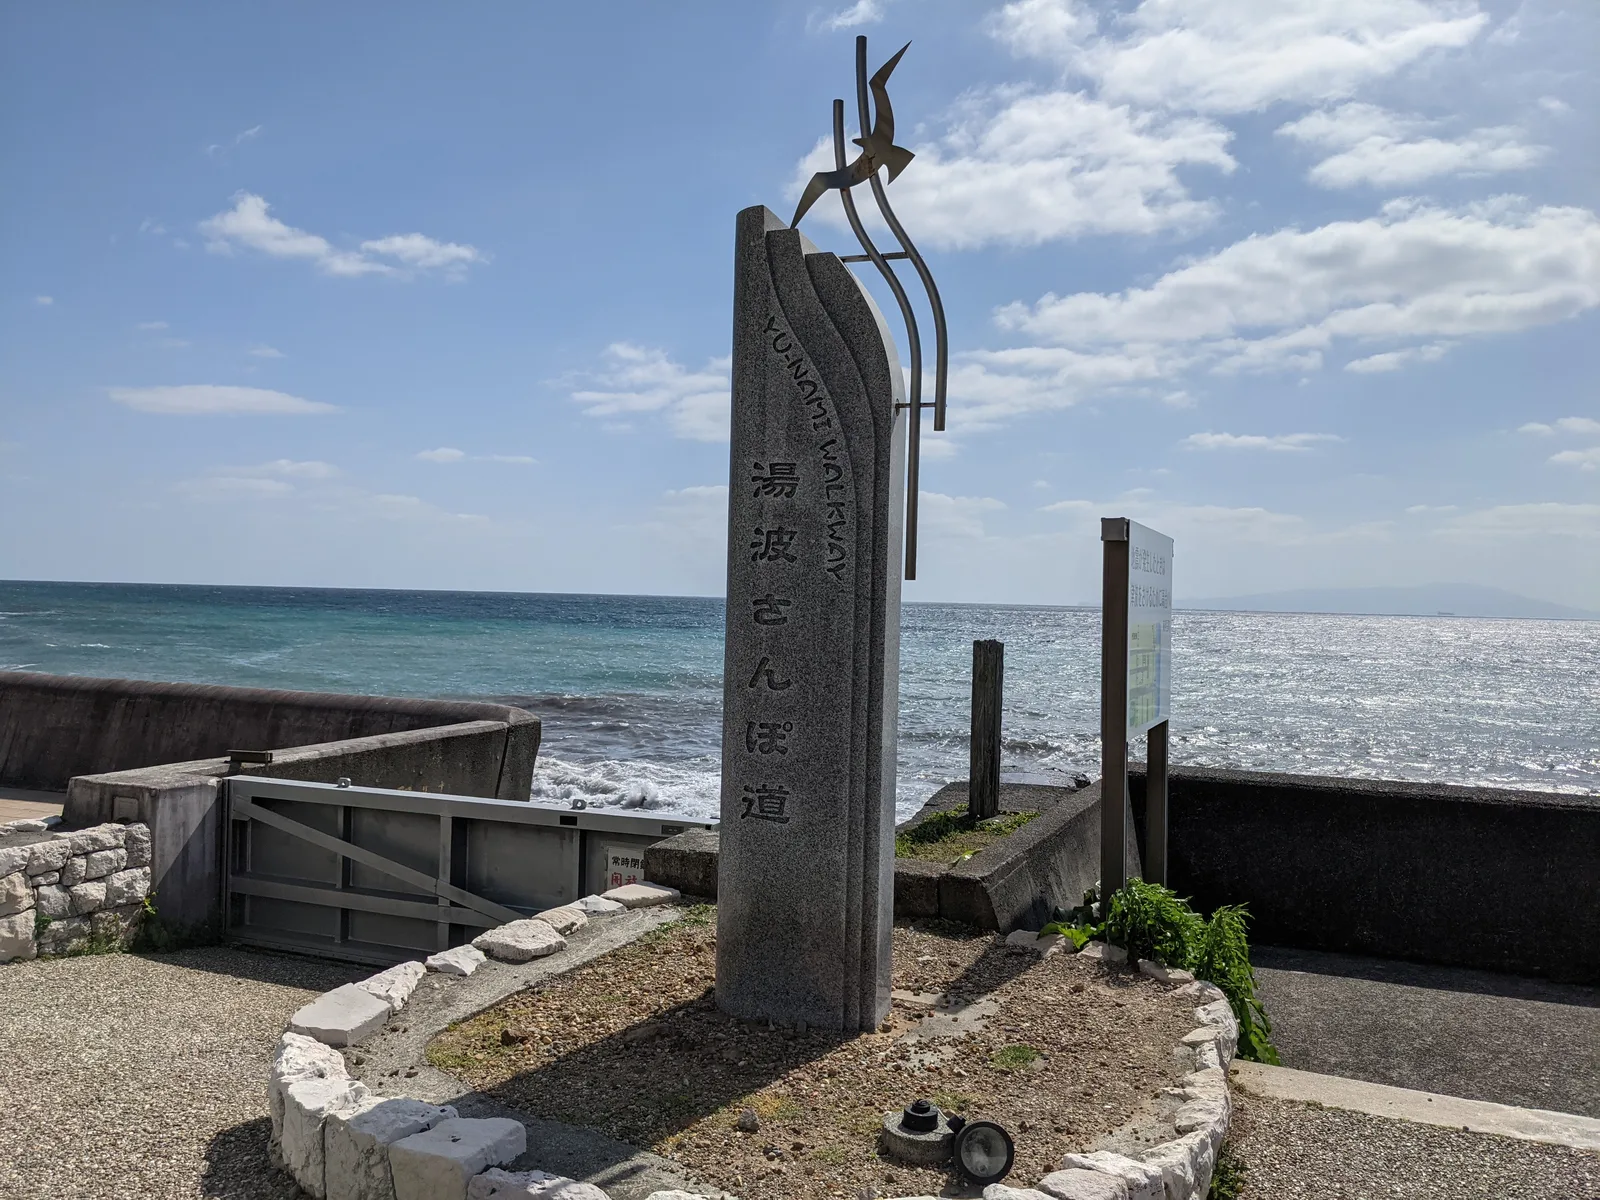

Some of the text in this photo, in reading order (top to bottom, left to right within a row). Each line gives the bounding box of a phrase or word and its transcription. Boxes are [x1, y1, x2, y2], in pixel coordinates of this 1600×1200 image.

[763, 316, 847, 581] YU-NAMI WALKWAY
[741, 461, 800, 824] 湯波さんぽ道
